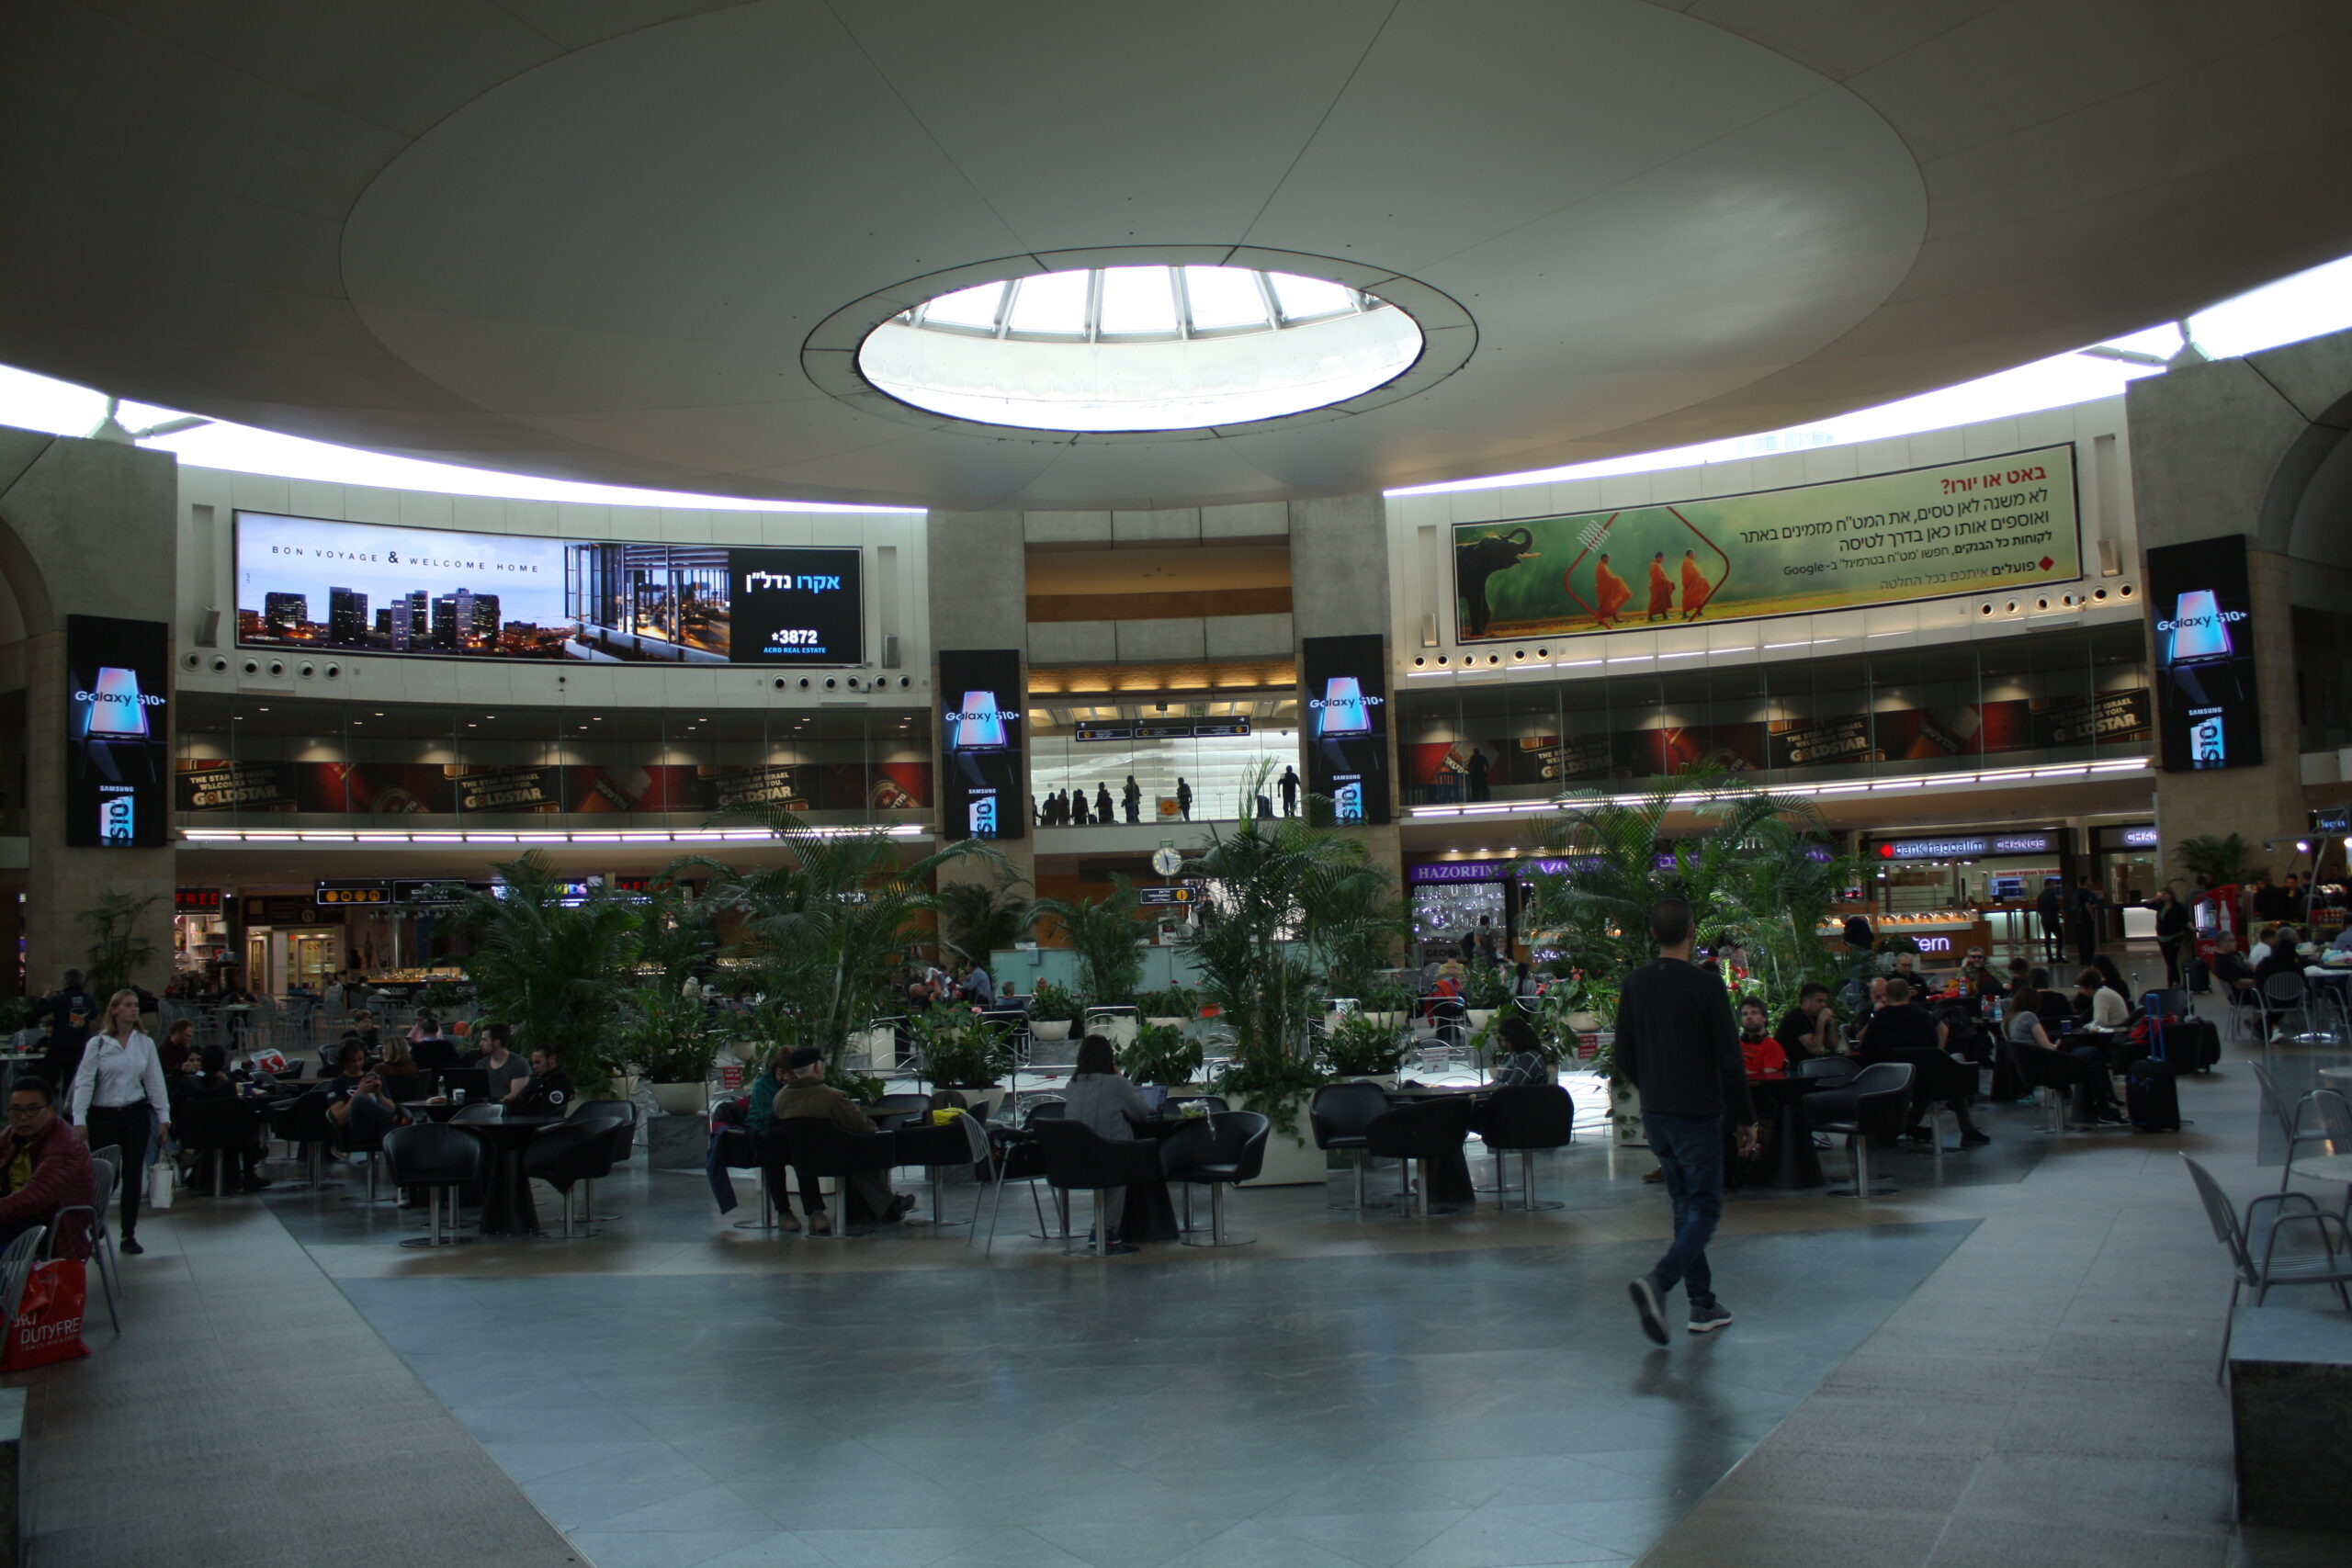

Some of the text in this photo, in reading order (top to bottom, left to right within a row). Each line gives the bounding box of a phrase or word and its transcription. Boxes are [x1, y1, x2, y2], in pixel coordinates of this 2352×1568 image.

[1941, 467, 2047, 495] באט או יורו?
[1984, 494, 2026, 511] משנה
[2029, 488, 2048, 503] לא
[1957, 499, 1980, 518] לאן
[1888, 512, 1911, 526] את
[1739, 529, 1780, 544] באתר
[1782, 522, 1833, 540] מזמינים
[1839, 511, 2050, 552] ואוספים אותו כאן בדרך לטיסה
[2011, 532, 2052, 546] לקוחות
[1995, 537, 2009, 548] כל
[272, 546, 539, 573] BON VOYAGE & WELCOME HOME
[1921, 546, 1950, 558] חפשו
[1783, 563, 1825, 577] Google
[1880, 561, 2036, 592] פועלים איתכם בכל החלטה
[797, 575, 842, 594] אקרו
[2156, 611, 2248, 631] Galaxy S10+
[74, 691, 168, 706] Galaxy S10+
[1309, 695, 1385, 709] Galaxy S10+
[2103, 698, 2133, 710] ISRAEL
[945, 711, 1021, 723] Galaxy S10+
[2188, 706, 2222, 716] SAMSUNG
[2199, 724, 2221, 767] S10
[190, 775, 208, 784] THE
[209, 773, 232, 783] STAR
[764, 772, 790, 781] ISRAEL
[1342, 788, 1358, 819] S10
[109, 803, 130, 840] S10
[976, 802, 993, 835] S10
[1894, 838, 2045, 855] bank hapoalim CHANGE
[1418, 864, 1501, 880] HAZORFIM
